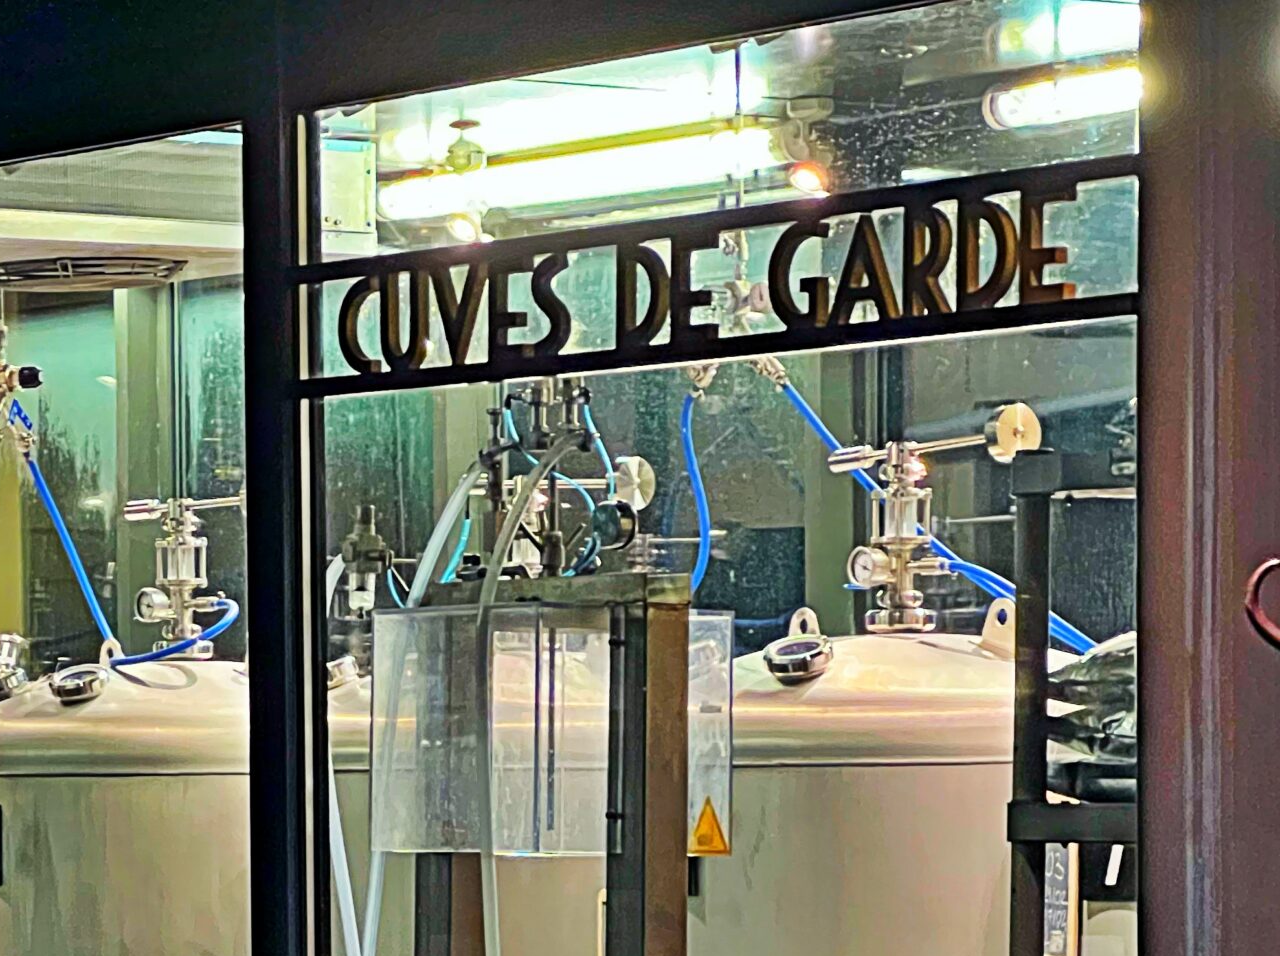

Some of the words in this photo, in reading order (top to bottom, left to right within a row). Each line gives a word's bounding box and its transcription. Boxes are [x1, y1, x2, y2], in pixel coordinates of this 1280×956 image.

[339, 253, 571, 374] CUVES
[617, 236, 720, 351] DE
[770, 195, 1077, 329] GARDE
